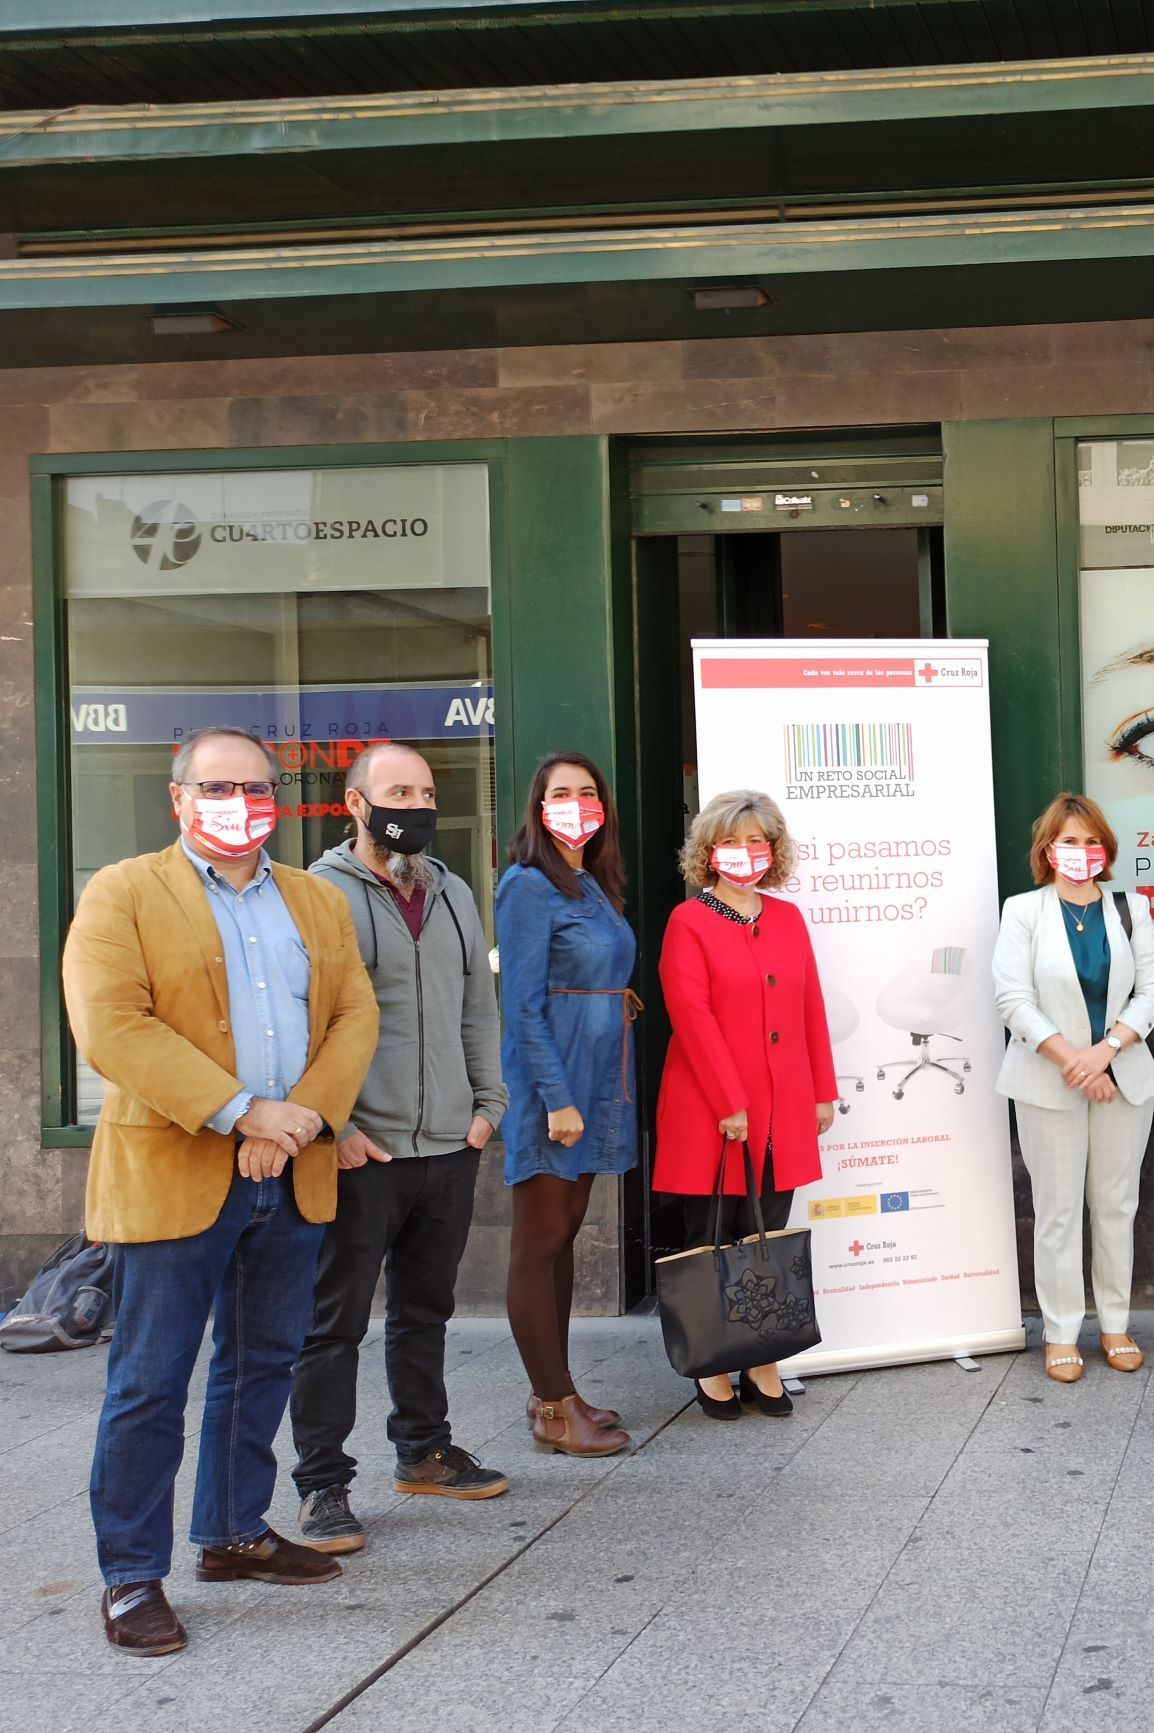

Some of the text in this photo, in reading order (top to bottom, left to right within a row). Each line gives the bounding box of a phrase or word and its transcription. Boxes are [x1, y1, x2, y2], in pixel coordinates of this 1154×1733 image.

[940, 667, 979, 679] Cruz Roja
[250, 721, 389, 738] CRUZ ROJA
[795, 769, 906, 782] UN RETO SOCIAL
[786, 783, 915, 800] EMPRESARIAL
[796, 837, 951, 866] si pasamos
[810, 867, 944, 892] reunirnos
[808, 897, 928, 925] unirnos?
[826, 1143, 846, 1152] POR
[847, 1142, 859, 1151] LA
[860, 1137, 909, 1149] INSERCIÓN
[911, 1134, 952, 1144] LABORAL
[837, 1154, 900, 1172] ¡SÚMATE!
[866, 1241, 897, 1250] Cruz Roja
